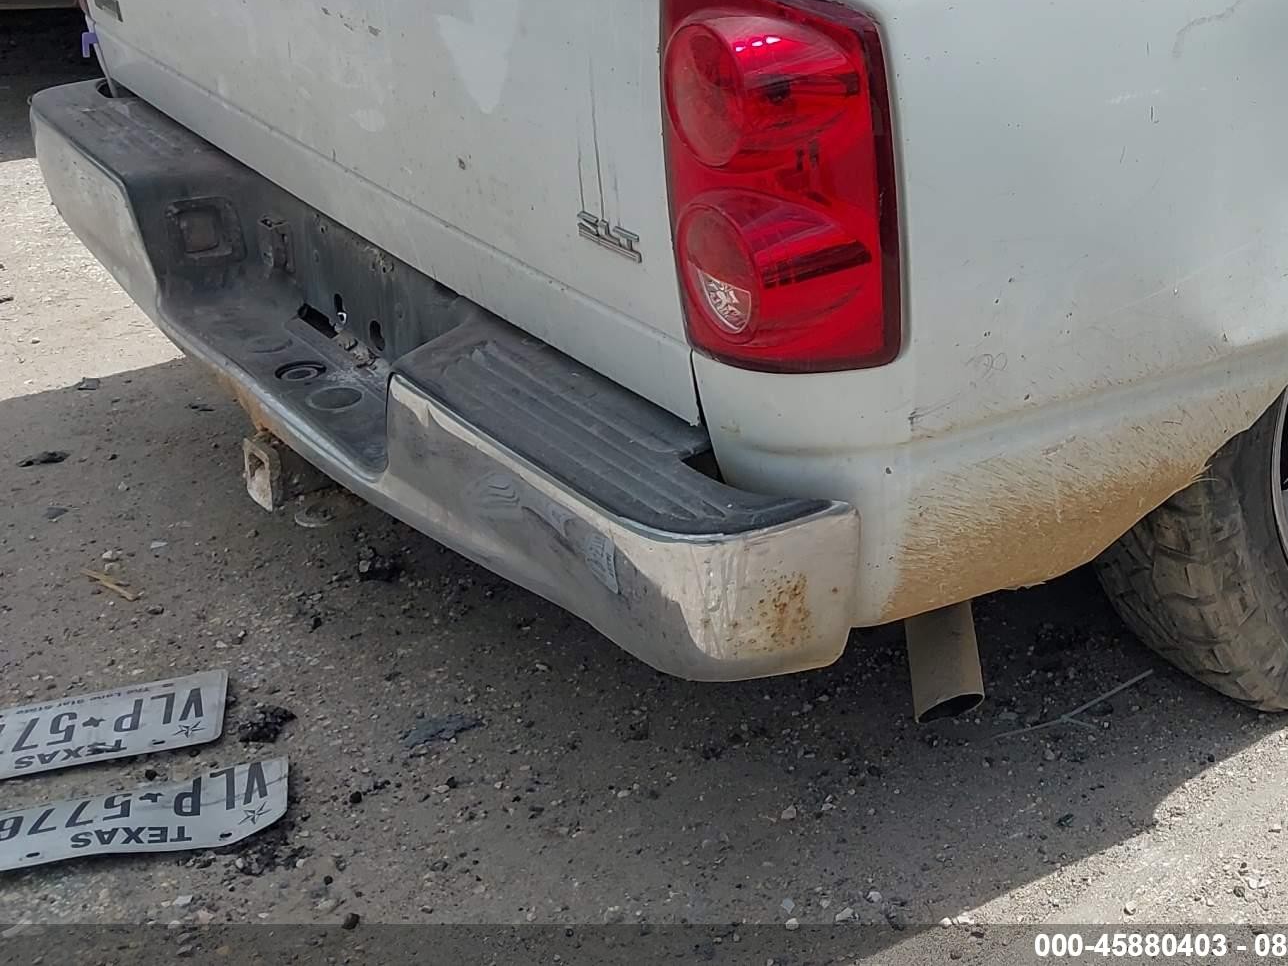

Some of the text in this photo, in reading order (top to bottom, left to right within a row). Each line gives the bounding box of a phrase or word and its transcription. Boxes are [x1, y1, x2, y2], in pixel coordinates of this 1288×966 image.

[577, 210, 642, 263] SLT
[113, 687, 204, 732] VLP
[14, 739, 127, 769] TEXAS
[173, 762, 268, 816] VLP
[70, 825, 192, 849] TEXAS
